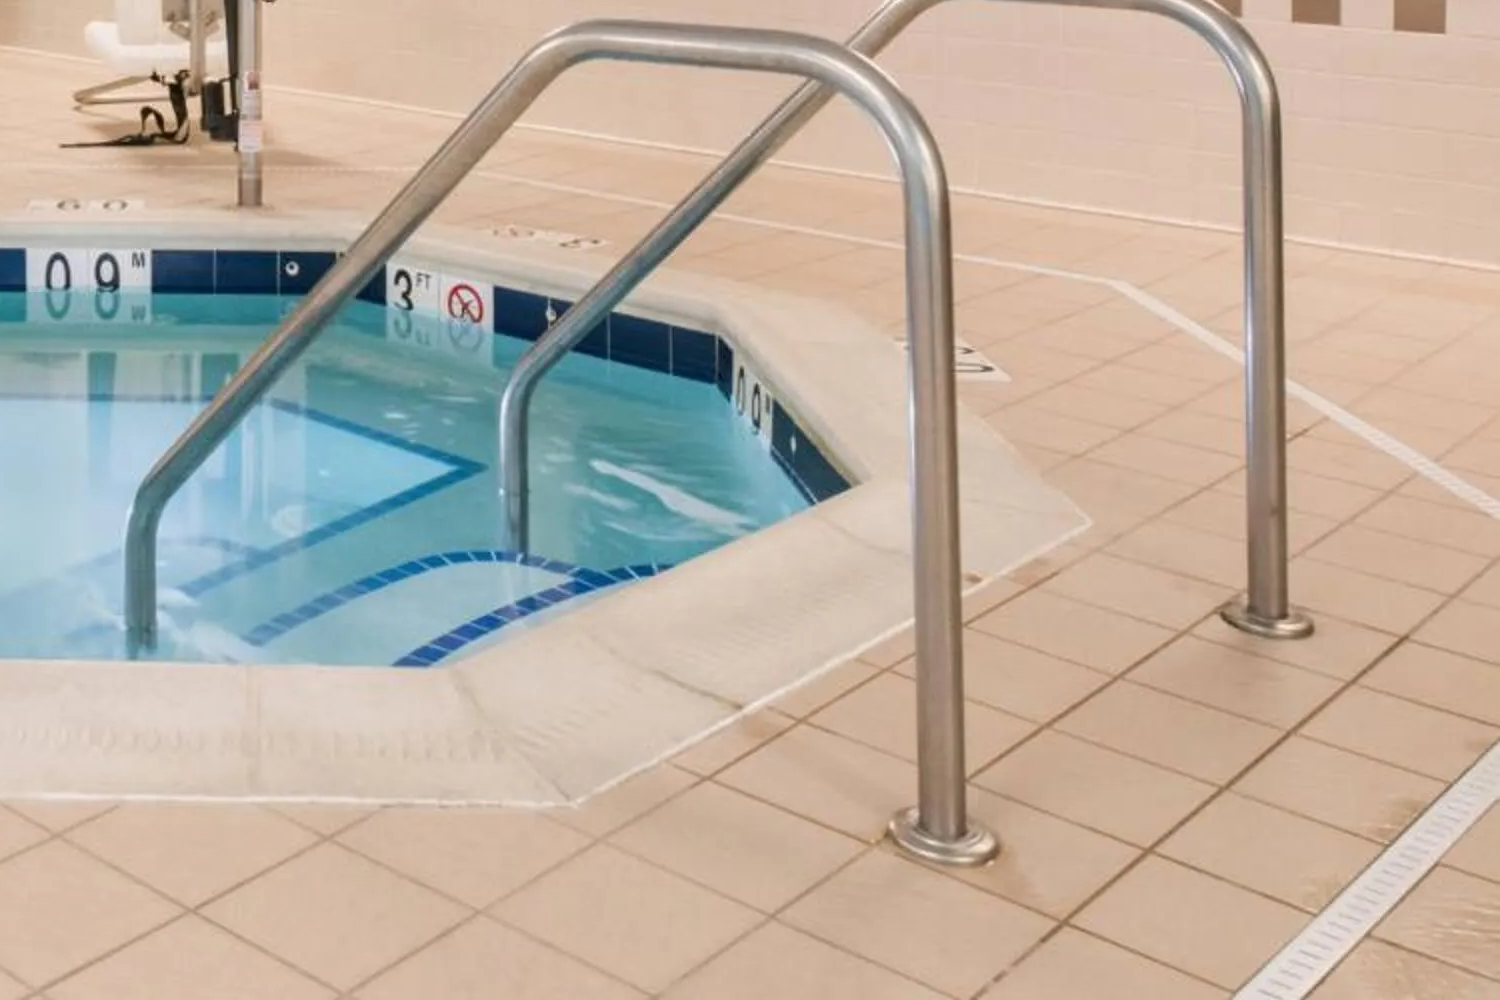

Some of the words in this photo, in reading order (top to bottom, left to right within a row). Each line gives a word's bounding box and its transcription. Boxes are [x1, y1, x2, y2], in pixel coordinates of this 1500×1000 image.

[131, 251, 146, 268] M
[394, 268, 413, 312] 3
[415, 272, 431, 289] FT
